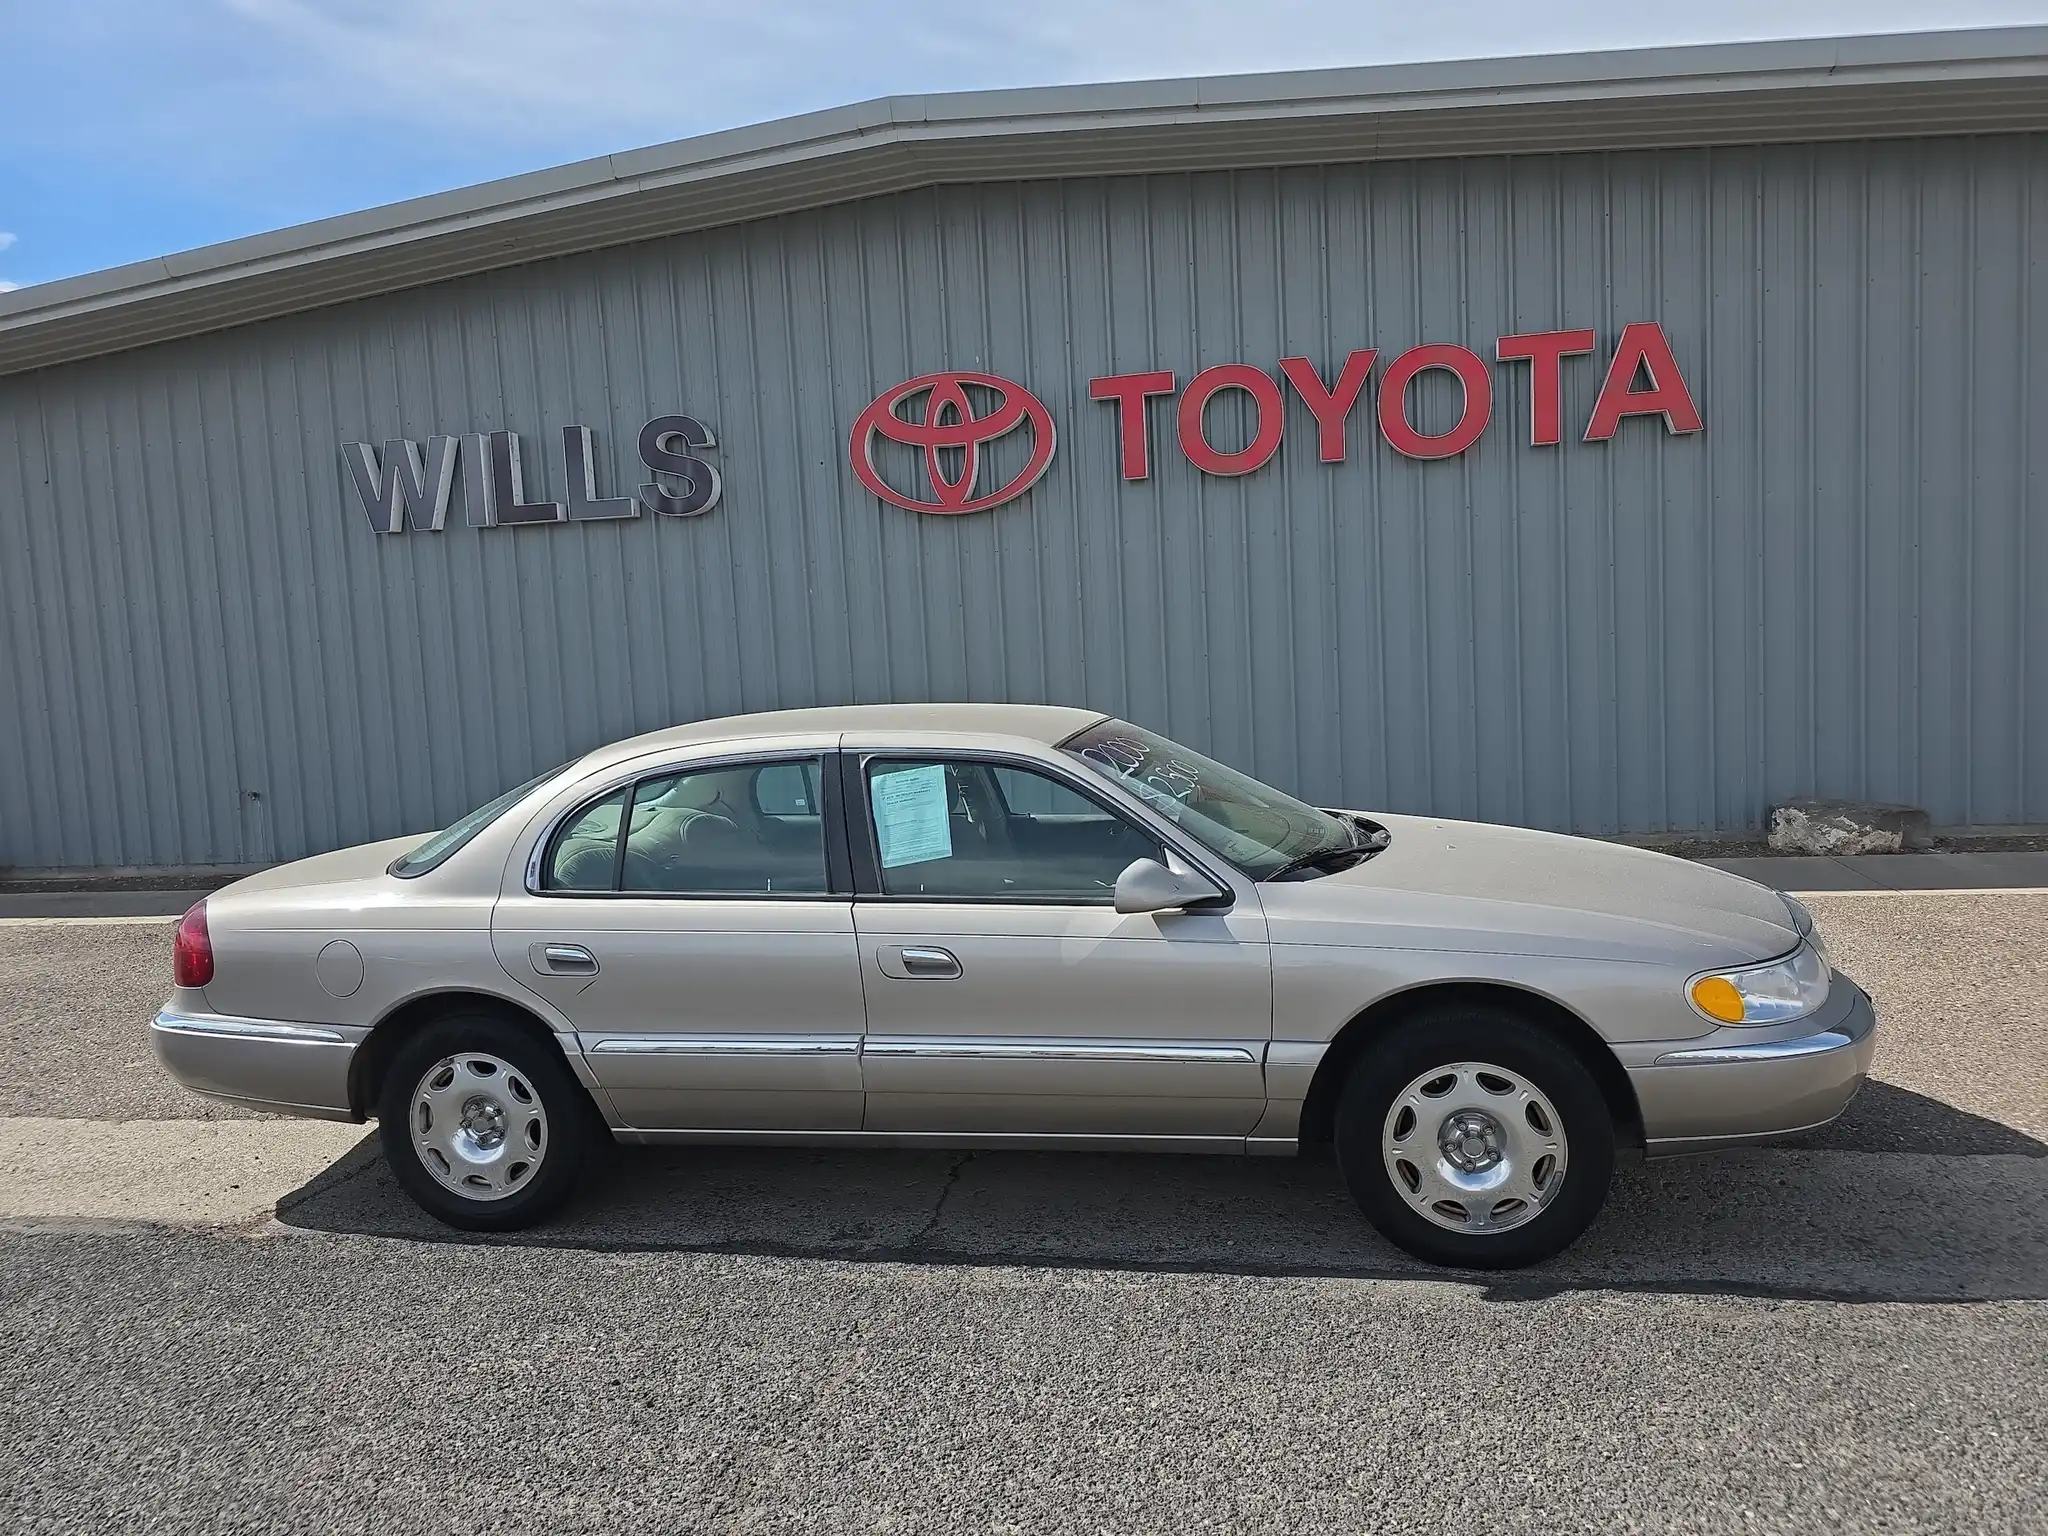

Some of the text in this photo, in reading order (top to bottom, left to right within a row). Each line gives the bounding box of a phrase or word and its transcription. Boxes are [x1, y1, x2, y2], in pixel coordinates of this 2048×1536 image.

[341, 321, 1704, 533] WILLS TOYOTA
[1081, 736, 1150, 780] 2000
